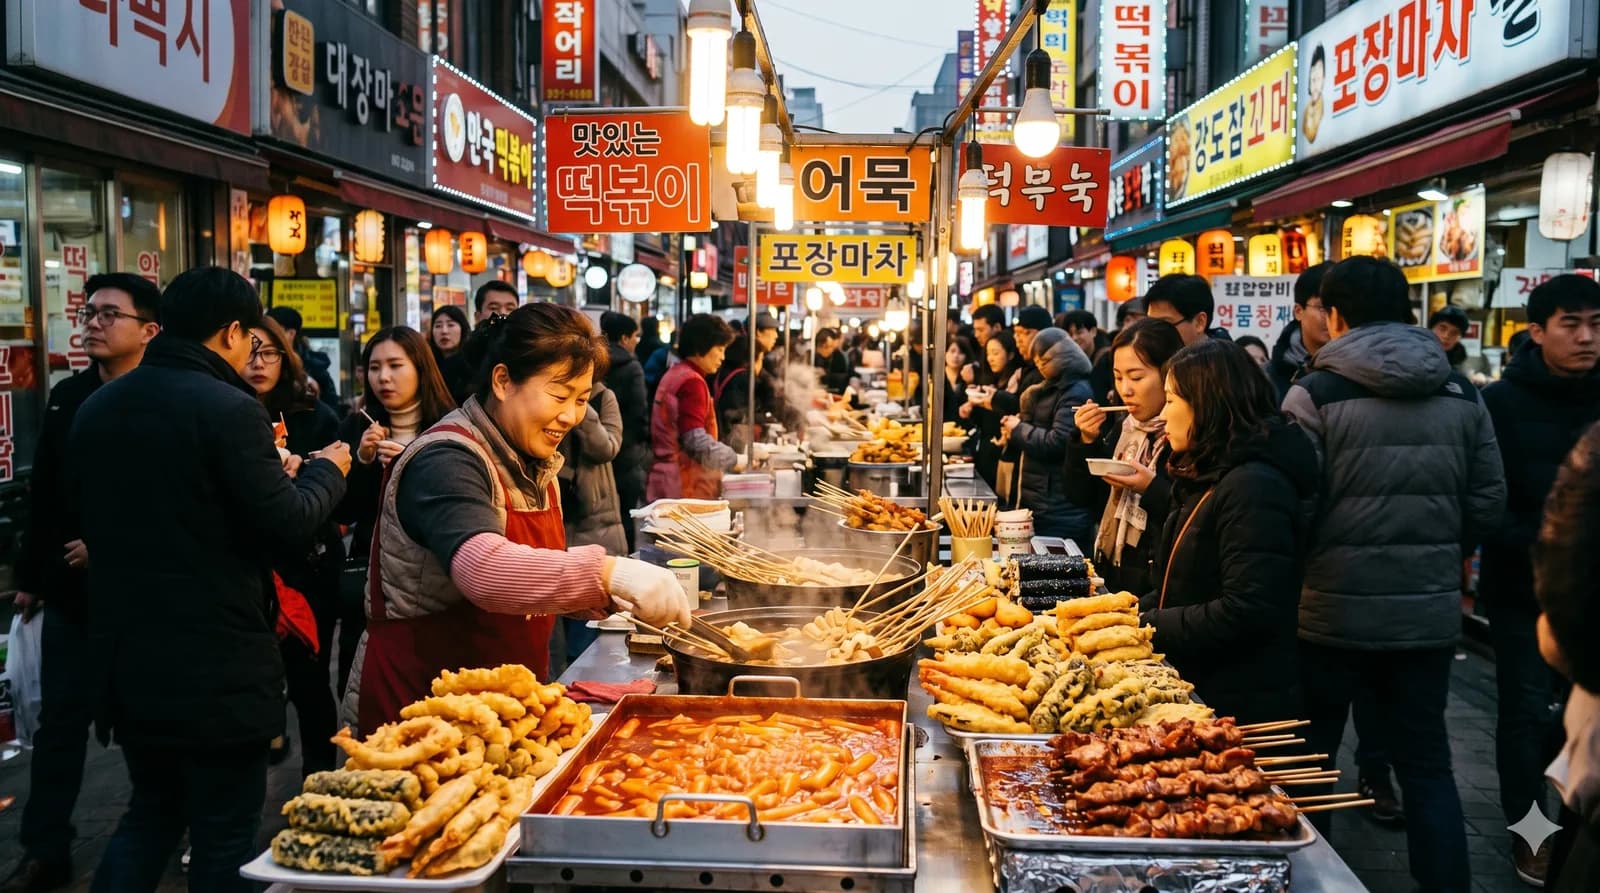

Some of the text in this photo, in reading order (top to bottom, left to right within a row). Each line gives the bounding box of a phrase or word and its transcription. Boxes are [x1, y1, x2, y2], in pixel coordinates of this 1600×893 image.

[554, 0, 584, 84] 작어리
[572, 121, 660, 158] 맛있는
[556, 163, 701, 225] 떡볶이
[800, 155, 916, 213] 어묵
[768, 241, 909, 278] 포장마차
